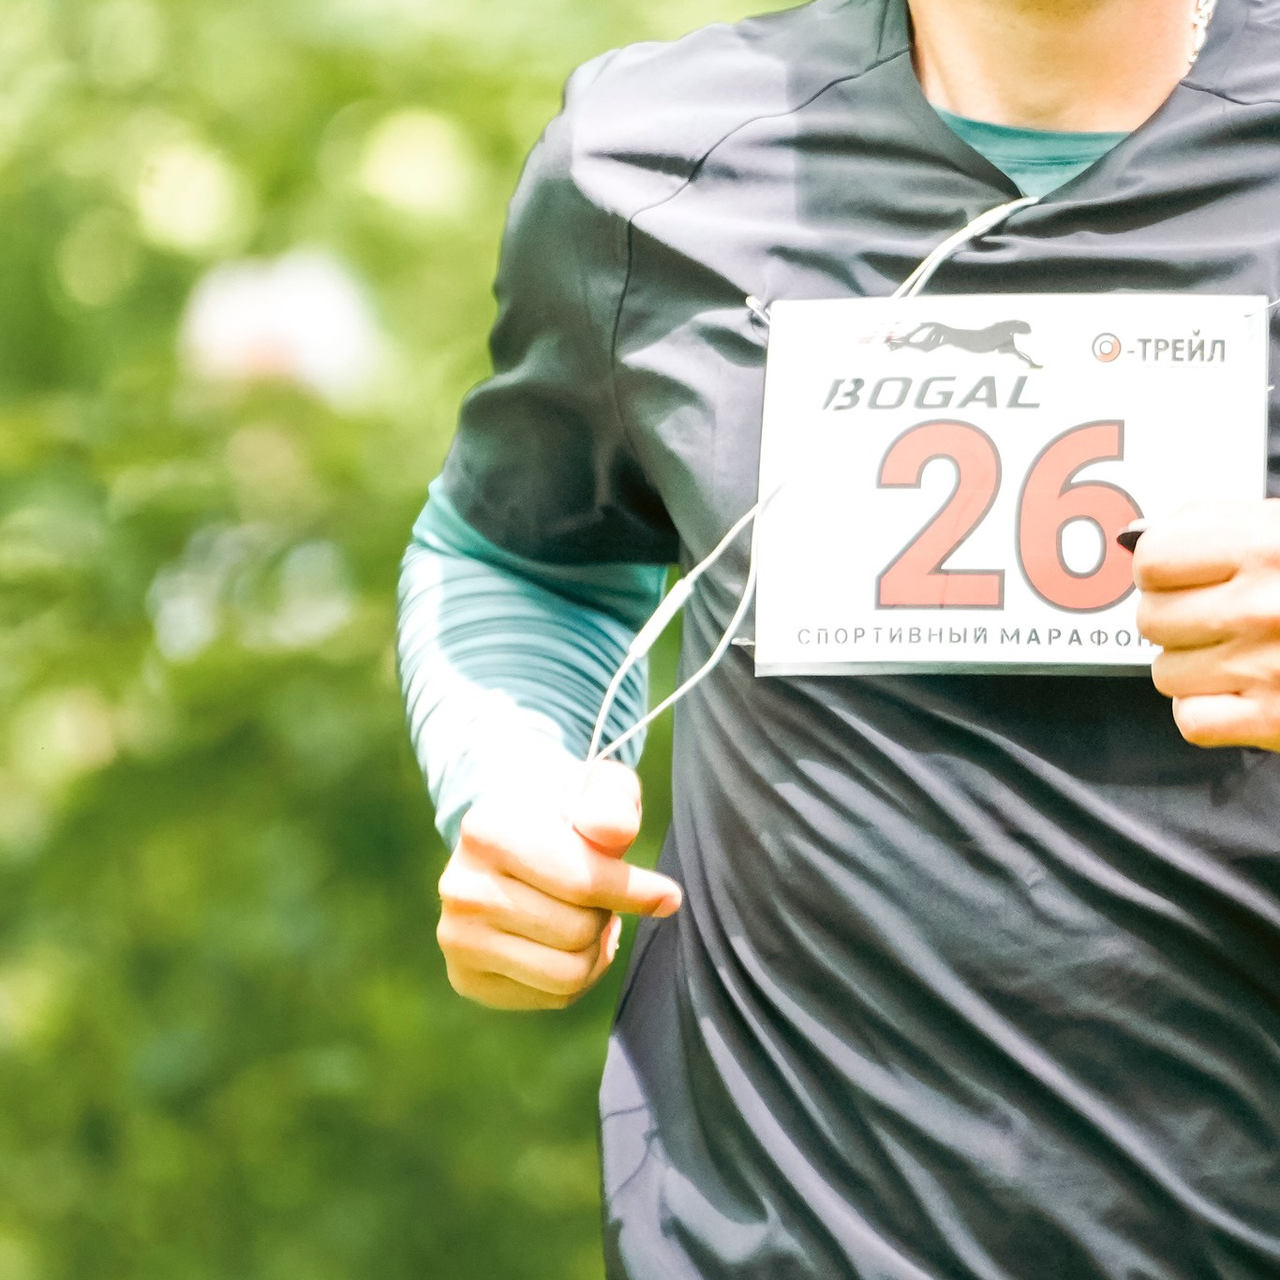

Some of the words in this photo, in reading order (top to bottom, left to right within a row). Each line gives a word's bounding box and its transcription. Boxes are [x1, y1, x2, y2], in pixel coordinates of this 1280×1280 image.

[822, 376, 1041, 411] BOGAL
[874, 418, 1146, 615] 26
[797, 626, 987, 645] СПОРТИВНЫЙ
